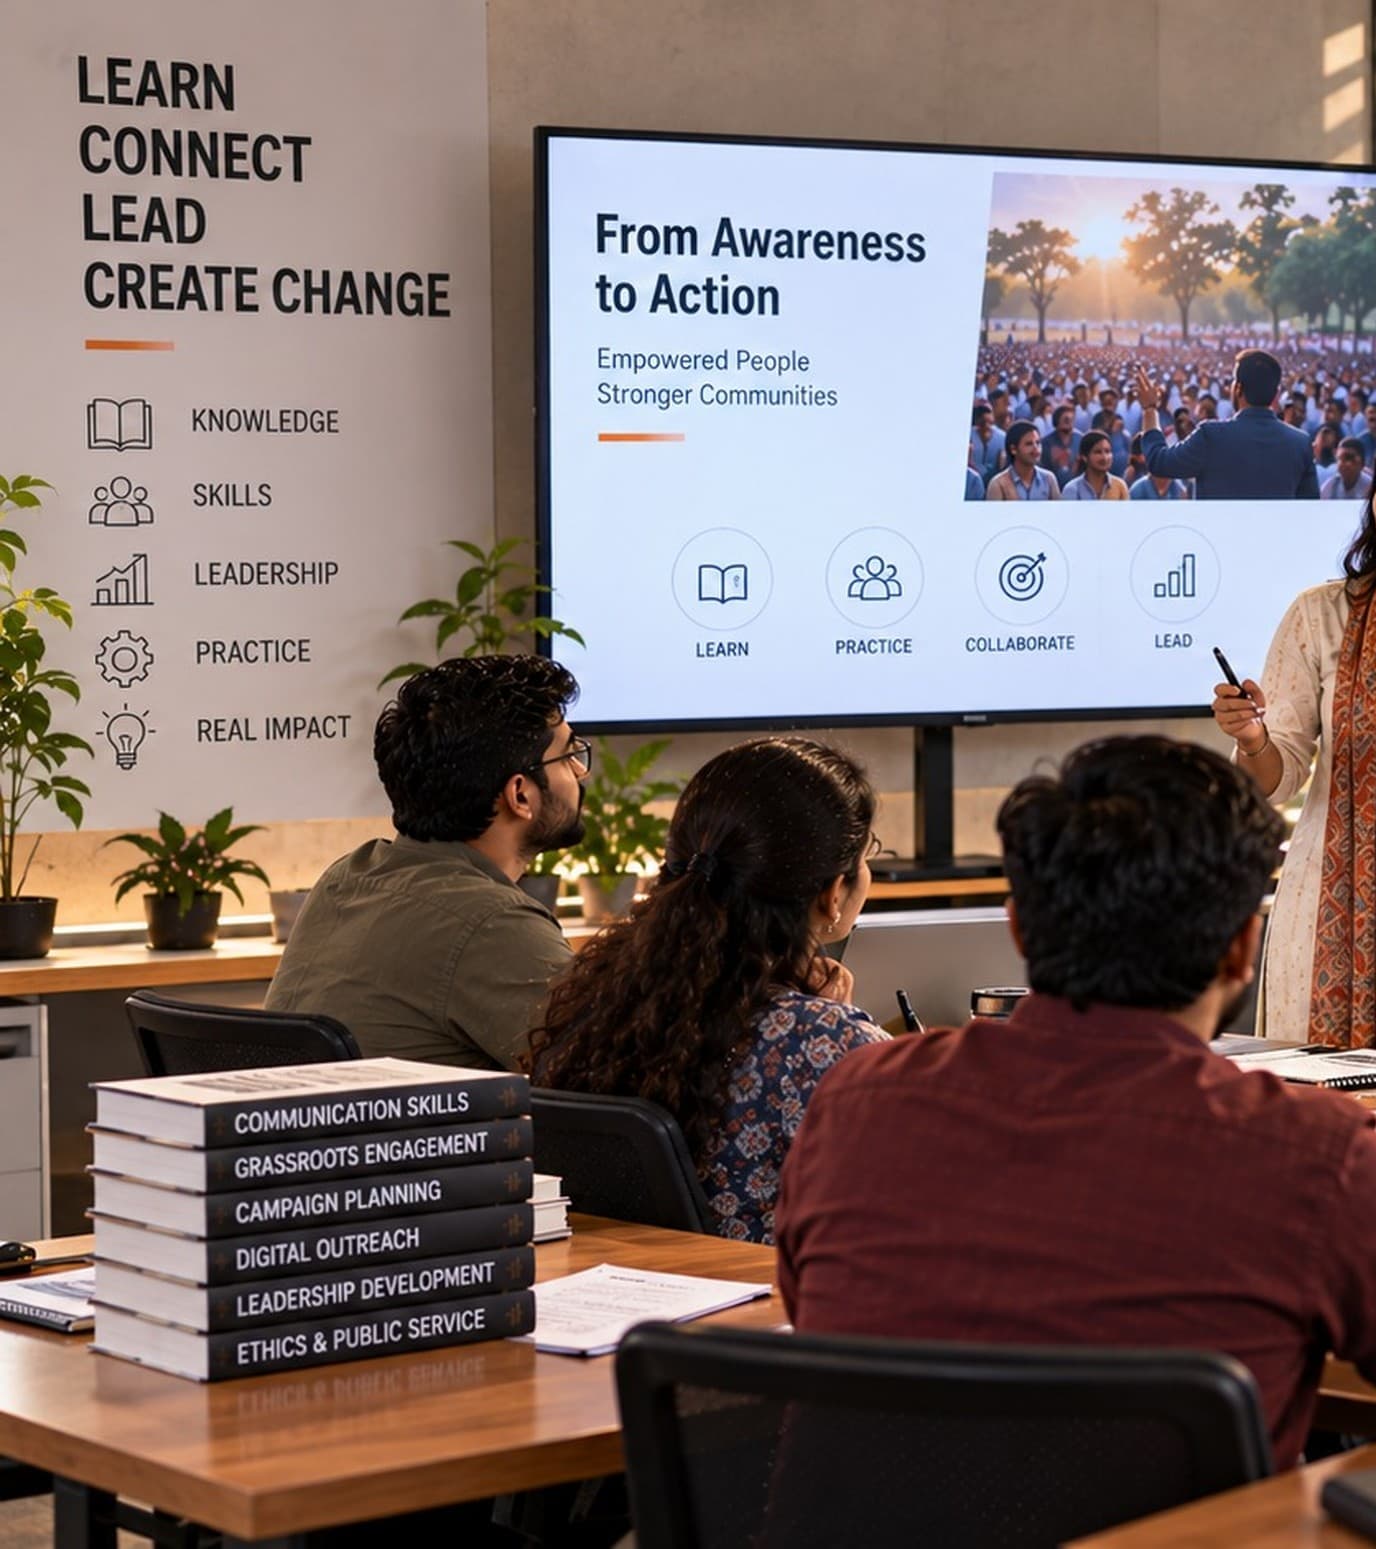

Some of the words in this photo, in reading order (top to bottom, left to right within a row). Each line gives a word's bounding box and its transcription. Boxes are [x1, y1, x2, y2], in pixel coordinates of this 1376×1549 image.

[78, 56, 234, 111] LEARN
[80, 125, 311, 182] CONNECT
[83, 194, 205, 244] LEAD
[597, 213, 697, 255] From
[712, 217, 925, 262] Awareness
[85, 262, 259, 312] CREATE
[273, 268, 451, 317] CHANGE
[596, 275, 636, 312] to
[650, 274, 779, 315] Action
[598, 348, 728, 374] Empowered
[737, 350, 809, 376] People
[598, 382, 692, 410] Stronger
[700, 384, 837, 406] Communities
[193, 409, 339, 433] KNOWLEDGE
[194, 484, 271, 506] SKILLS
[195, 562, 338, 585] LEADERSHIP
[197, 639, 310, 664] PRACTICE
[697, 642, 748, 657] LEARN
[836, 639, 912, 654] PRACTICE
[966, 636, 1074, 652] COLLABORATE
[1155, 634, 1192, 648] LEAD
[198, 718, 257, 742] REAL
[266, 715, 351, 740] IMPACT
[235, 1098, 401, 1133] COMMUNICATION
[408, 1092, 468, 1116] SKILLS
[235, 1146, 359, 1178] GRASSROOTS
[365, 1131, 488, 1164] ENGAGEMENT
[236, 1192, 338, 1223] CAMPAIGN
[345, 1180, 441, 1210] PLANNING
[237, 1242, 311, 1270] DIGITAL
[317, 1227, 419, 1259] OUTREACH
[238, 1281, 355, 1316] LEADERSHIP
[361, 1262, 495, 1299] DEVELOPMENT
[238, 1334, 307, 1364] ETHICS
[313, 1332, 327, 1353] &
[334, 1320, 402, 1350] PUBLIC
[409, 1308, 485, 1338] SERVICE
